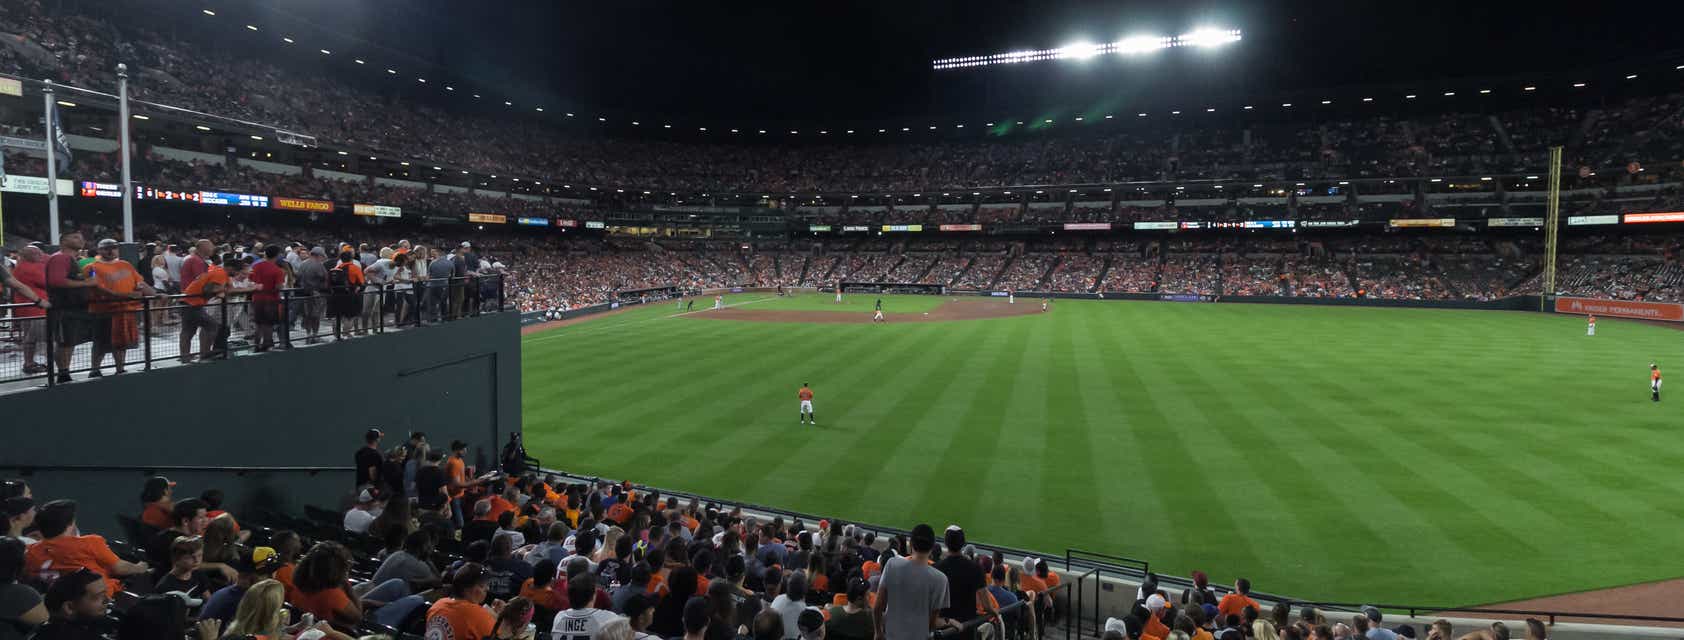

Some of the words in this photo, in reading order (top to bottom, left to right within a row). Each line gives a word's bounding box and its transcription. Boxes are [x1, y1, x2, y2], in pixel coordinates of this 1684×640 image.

[280, 199, 305, 208] WELLS
[306, 201, 329, 210] FARGO
[565, 619, 588, 632] INGE
